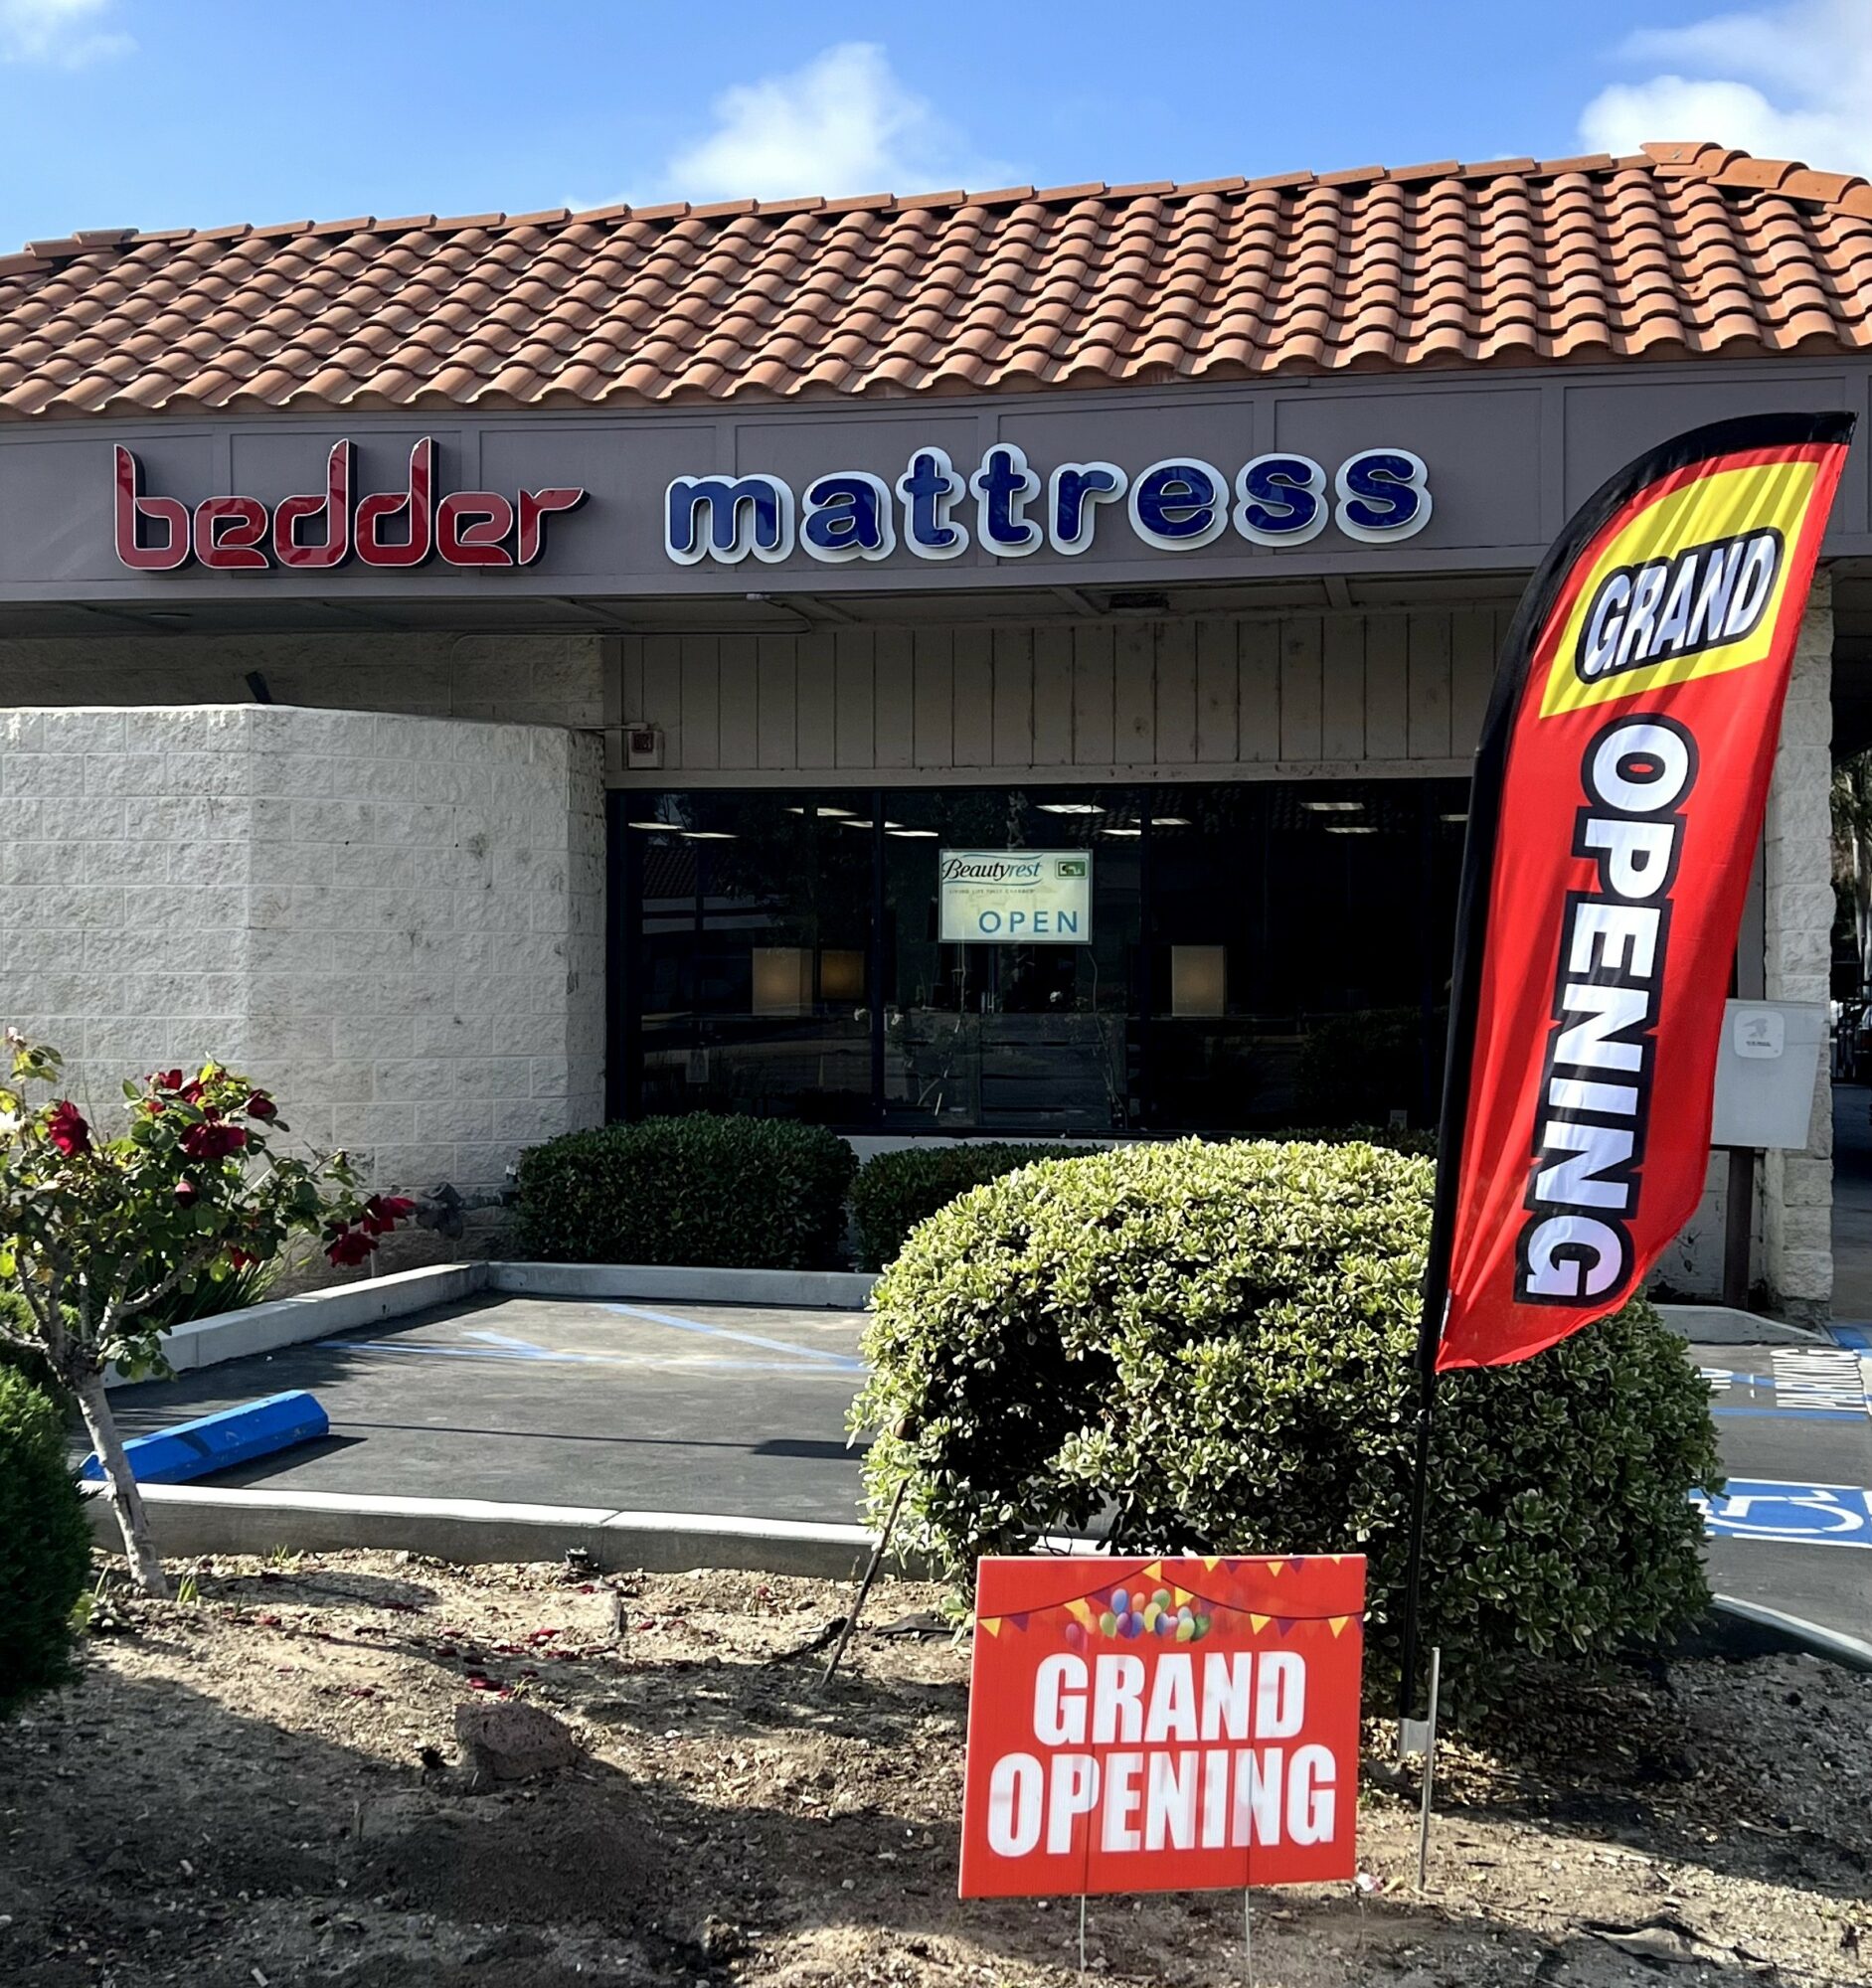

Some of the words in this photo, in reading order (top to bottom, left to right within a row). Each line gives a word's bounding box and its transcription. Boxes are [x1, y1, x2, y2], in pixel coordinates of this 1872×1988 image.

[112, 434, 586, 571] bedder
[664, 442, 1433, 566] mattress
[1583, 533, 1779, 677] GRAND
[941, 858, 1042, 882] Beautyrest
[978, 911, 1078, 933] OPEN
[1524, 722, 1691, 1298] OPENING
[1770, 1348, 1868, 1411] PARKING
[1032, 1650, 1306, 1746] GRAND
[986, 1743, 1338, 1858] OPENING
